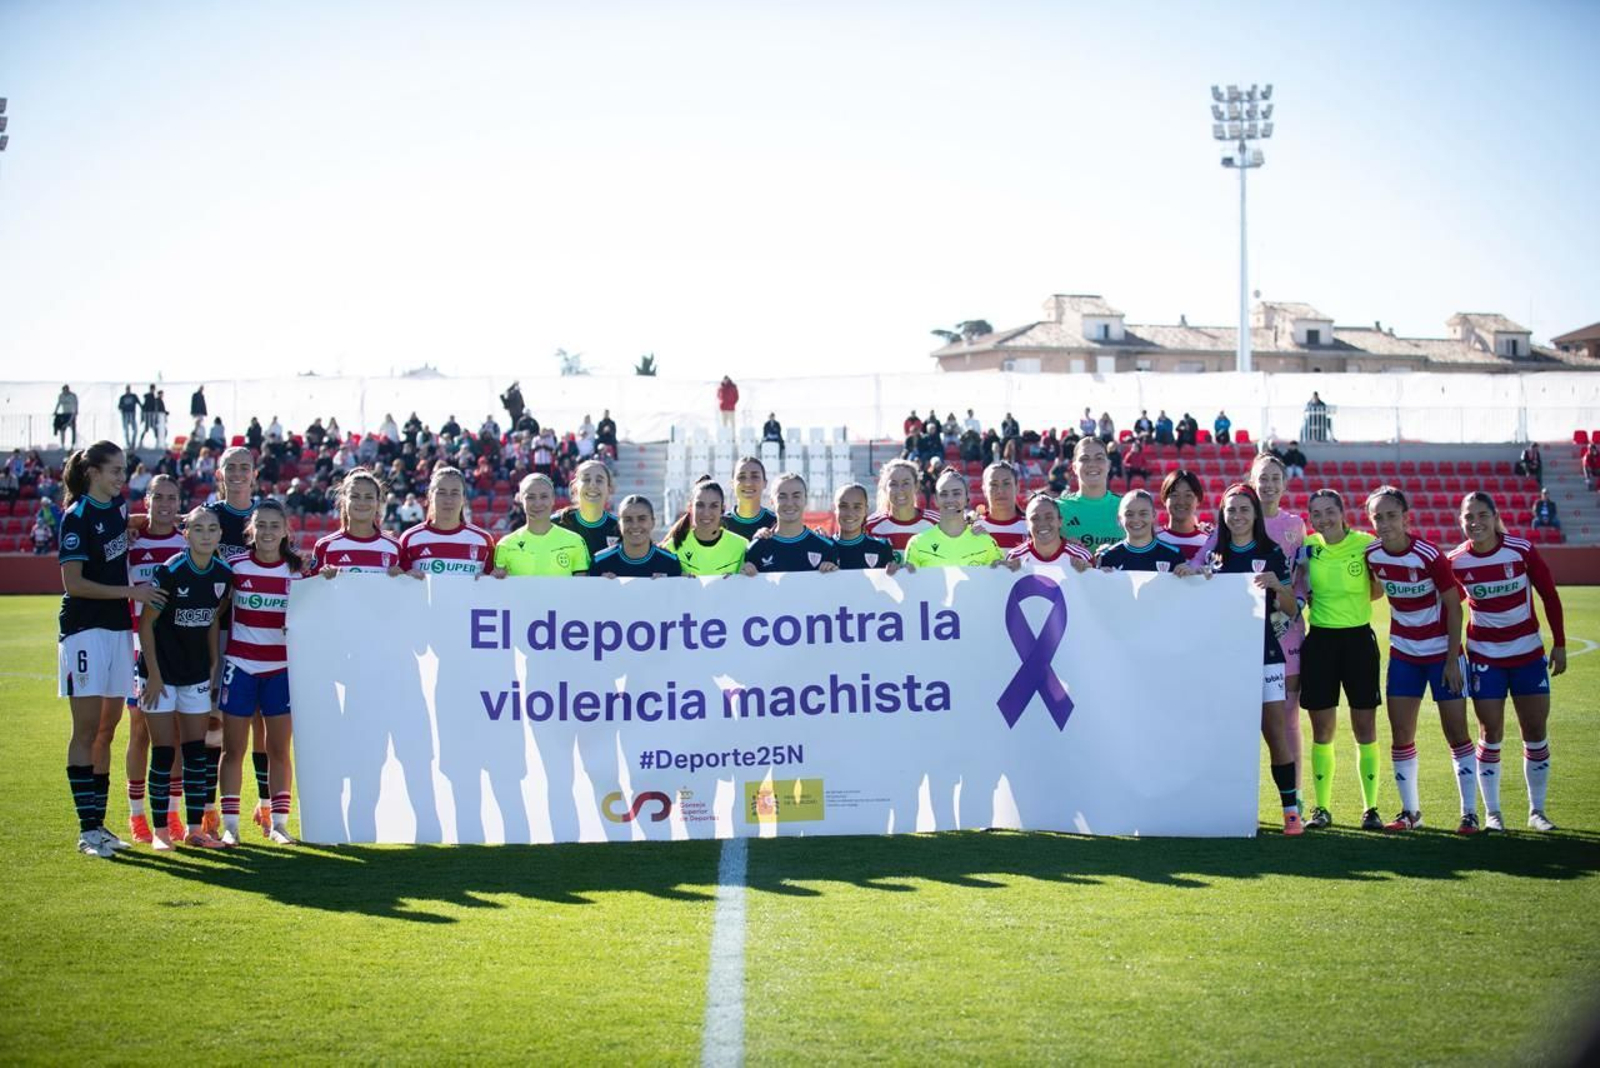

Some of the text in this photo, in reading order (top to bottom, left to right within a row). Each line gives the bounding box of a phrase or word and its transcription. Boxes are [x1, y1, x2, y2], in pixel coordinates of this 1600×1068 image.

[418, 559, 476, 574] TU SUPER
[1386, 581, 1426, 595] SUPER
[1473, 581, 1519, 598] SUPER
[248, 594, 288, 609] SUPE
[471, 601, 961, 661] El deporte contra la
[77, 650, 88, 673] 6
[480, 673, 951, 722] violencia machista
[640, 744, 804, 773] #Deporte25N
